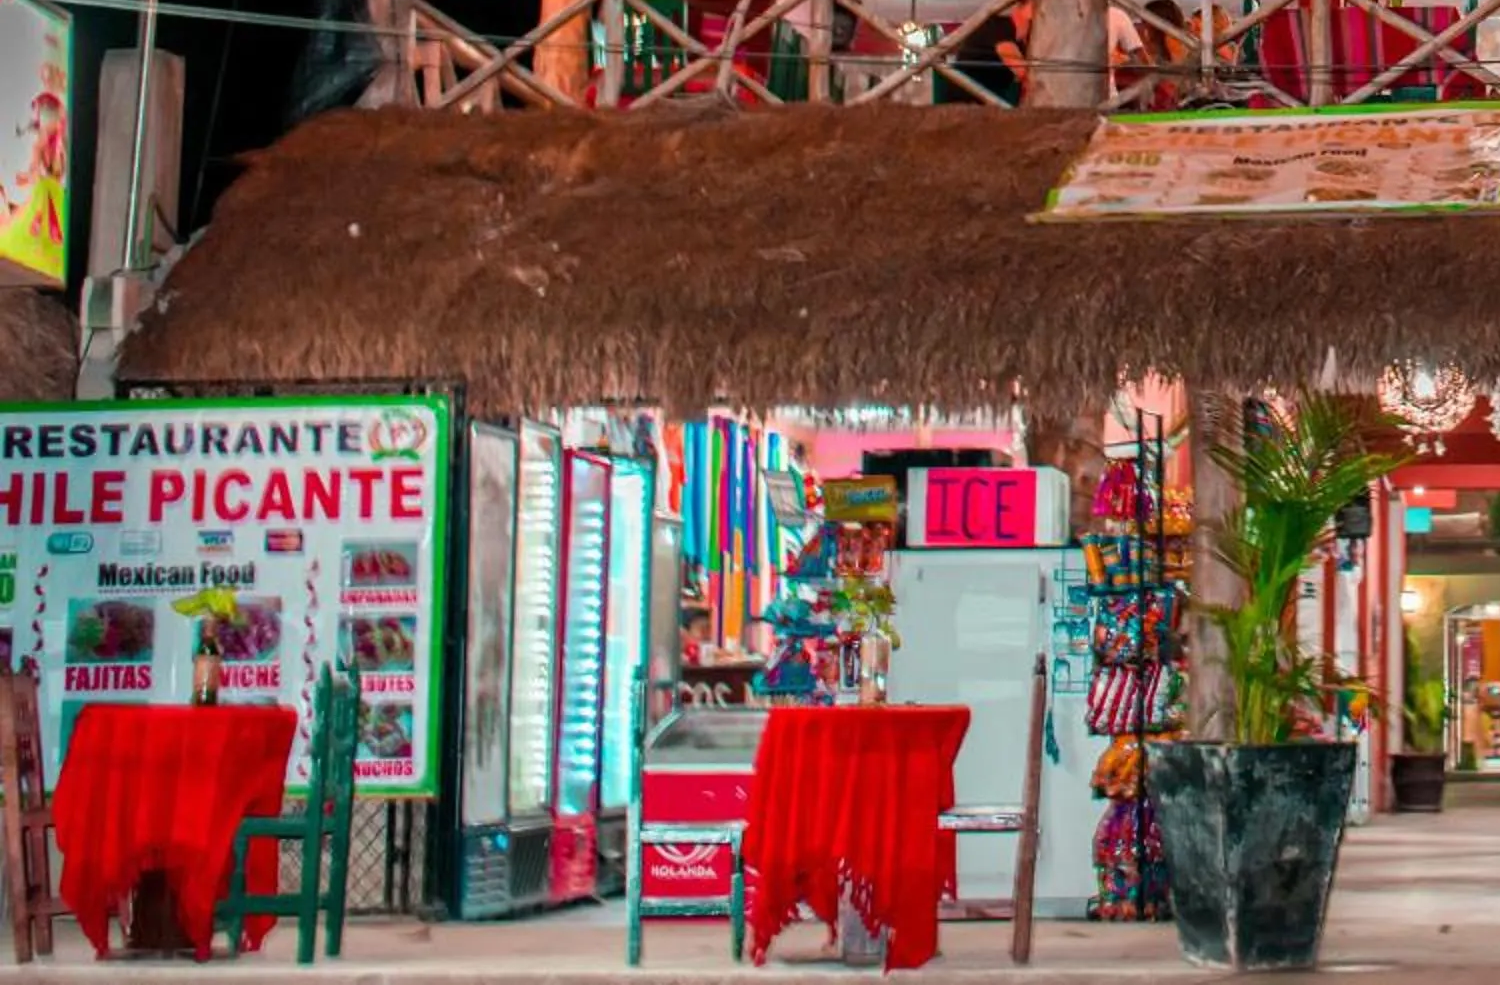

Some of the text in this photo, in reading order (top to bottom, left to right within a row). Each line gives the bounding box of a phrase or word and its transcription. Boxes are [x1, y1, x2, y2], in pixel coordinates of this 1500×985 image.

[3, 421, 363, 458] RESTAURANTE
[149, 468, 425, 523] PICANTE
[928, 476, 1018, 541] ICE
[98, 561, 255, 586] Mexican Food
[65, 665, 152, 692] FAJITAS
[219, 664, 280, 688] VICHE
[353, 760, 413, 778] NUCHOS
[650, 864, 718, 880] HOLANDA
